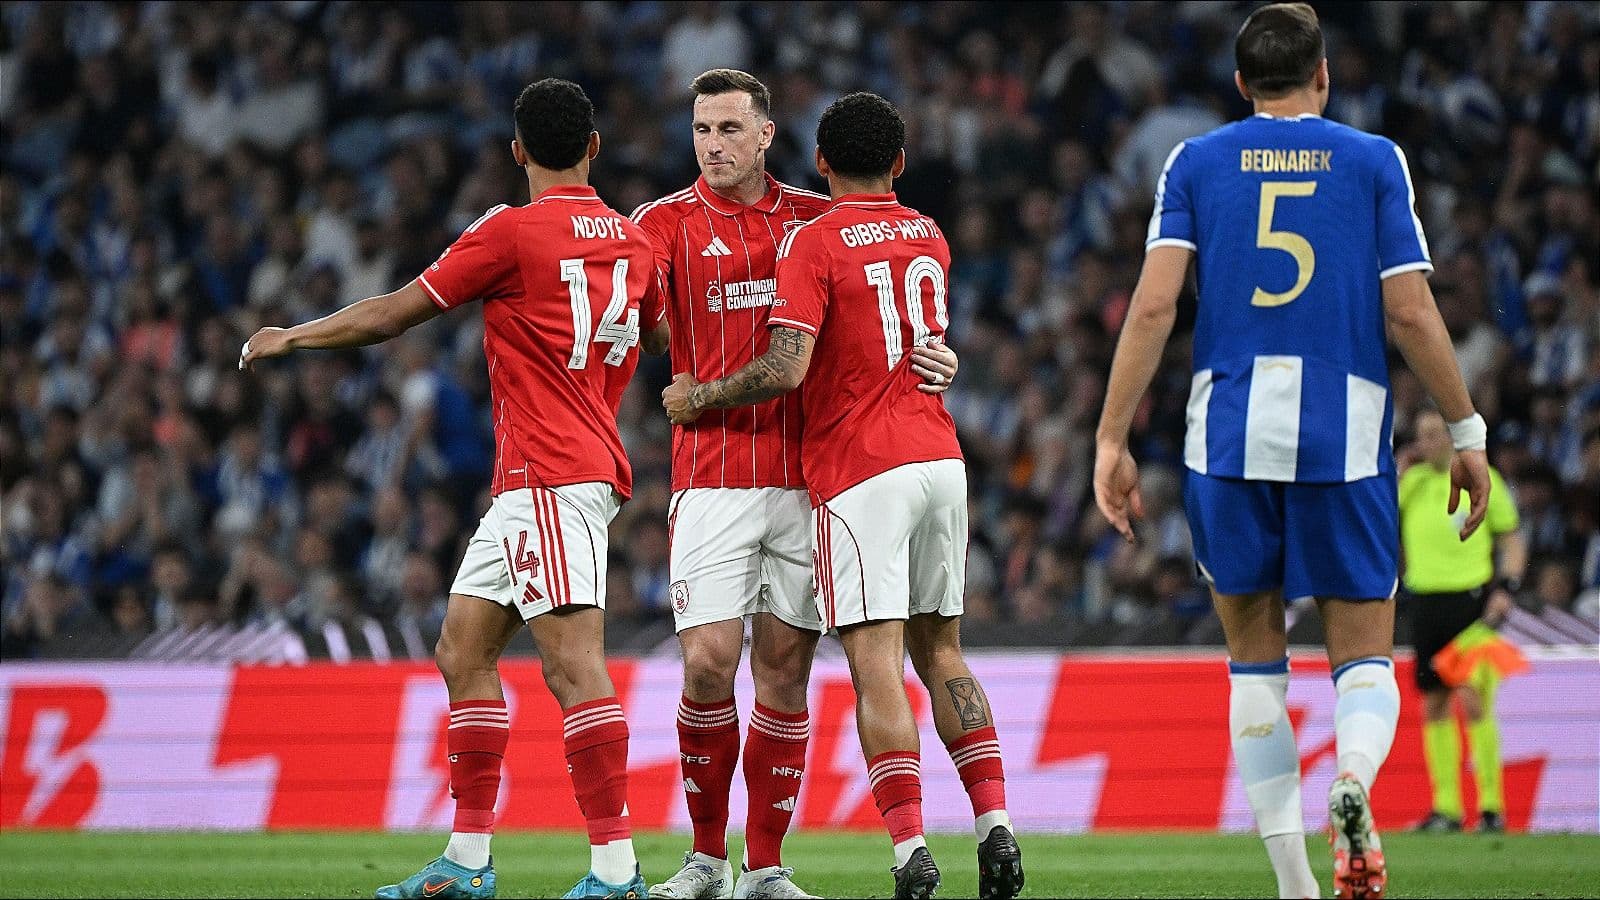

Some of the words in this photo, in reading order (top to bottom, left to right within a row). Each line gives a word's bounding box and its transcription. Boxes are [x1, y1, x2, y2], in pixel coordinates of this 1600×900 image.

[1240, 149, 1332, 173] BEDNAREK
[570, 215, 627, 241] NDOYE
[1251, 181, 1317, 308] 5
[559, 258, 641, 370] 14
[863, 255, 950, 372] 10
[503, 530, 541, 587] 14
